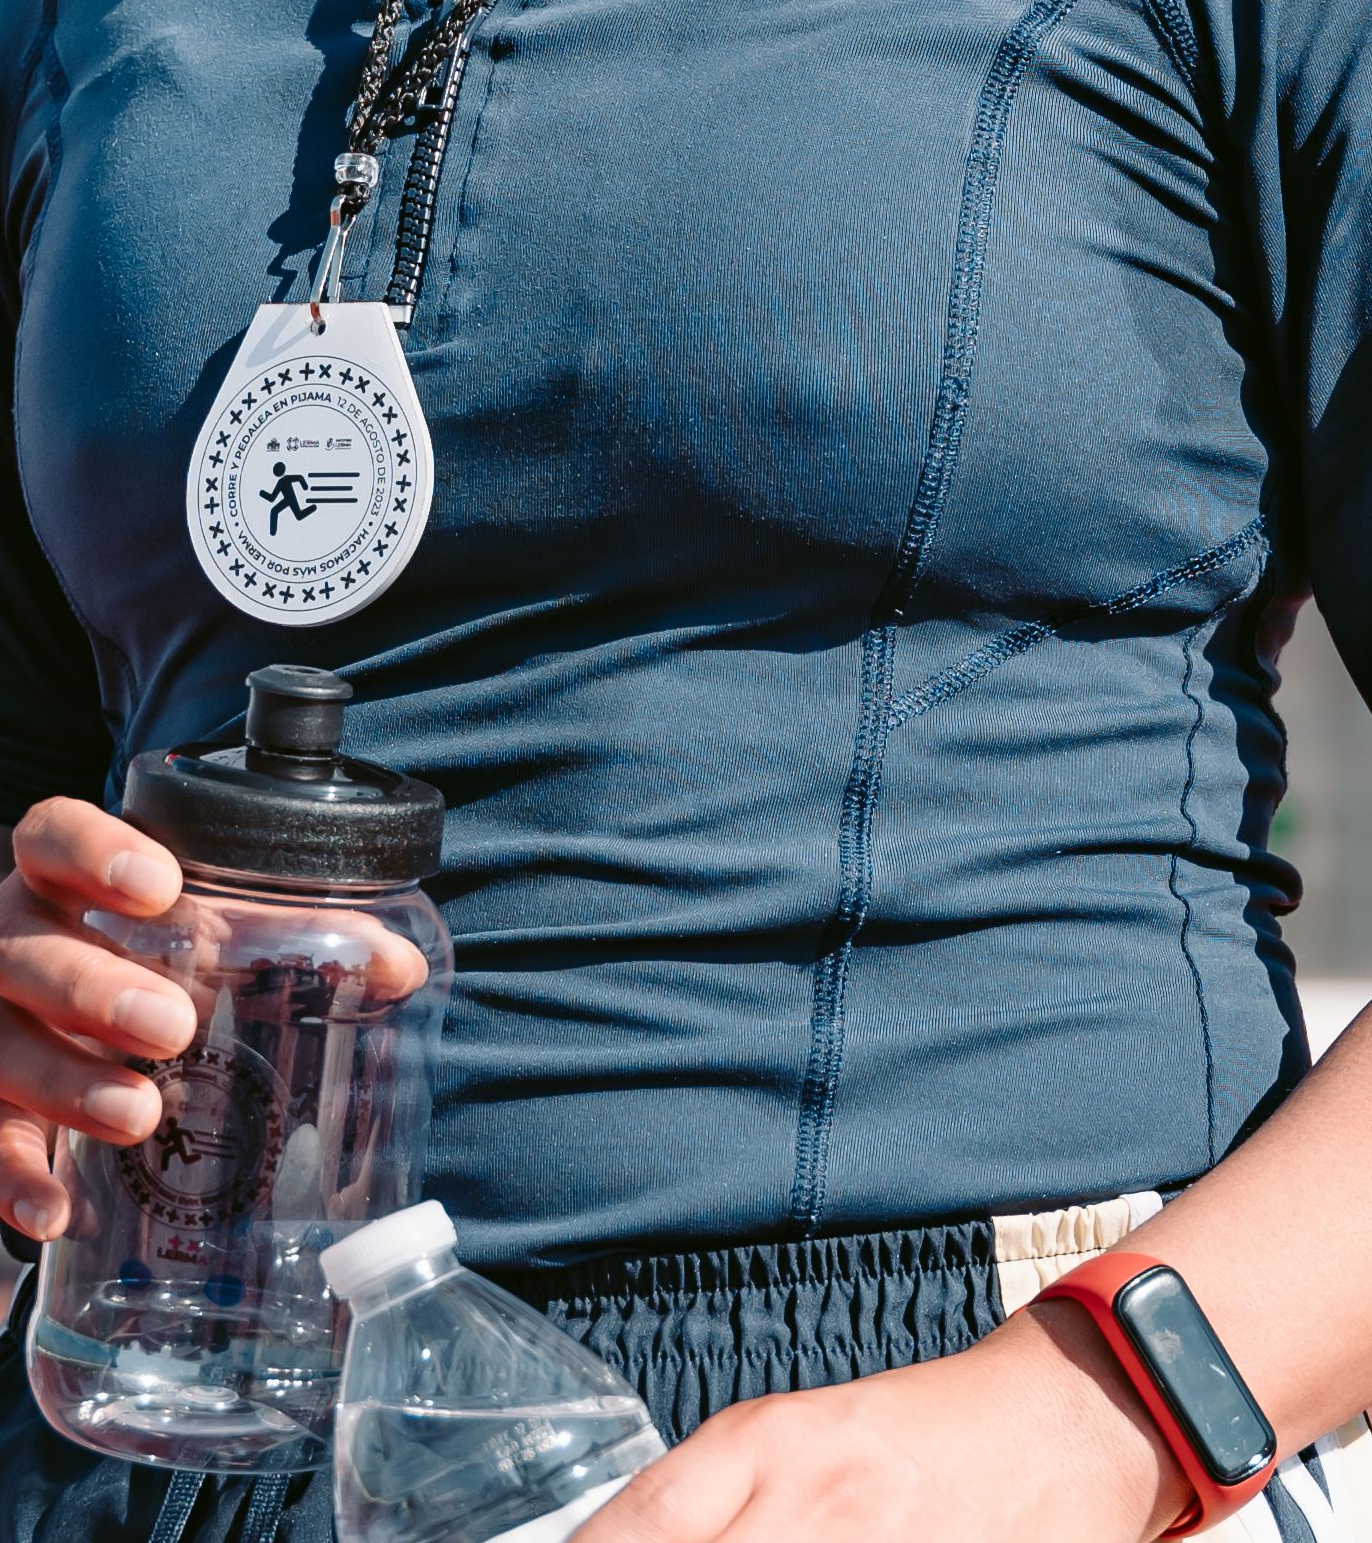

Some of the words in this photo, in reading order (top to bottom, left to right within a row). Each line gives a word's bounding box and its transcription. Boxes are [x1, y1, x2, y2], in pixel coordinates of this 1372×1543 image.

[272, 398, 288, 413] EN
[290, 391, 332, 404] PIJAMA
[337, 396, 347, 409] 12
[347, 403, 363, 419] DE
[234, 410, 273, 460] PEDALEA
[359, 418, 385, 464] AGOSTO
[230, 461, 239, 470] Y
[377, 466, 386, 484] DE
[228, 473, 238, 517] CORRE
[370, 487, 385, 517] 2023
[238, 529, 267, 565] LERMA
[319, 528, 369, 572] HACEMOS
[266, 559, 290, 575] POR
[292, 565, 316, 579] MÁS
